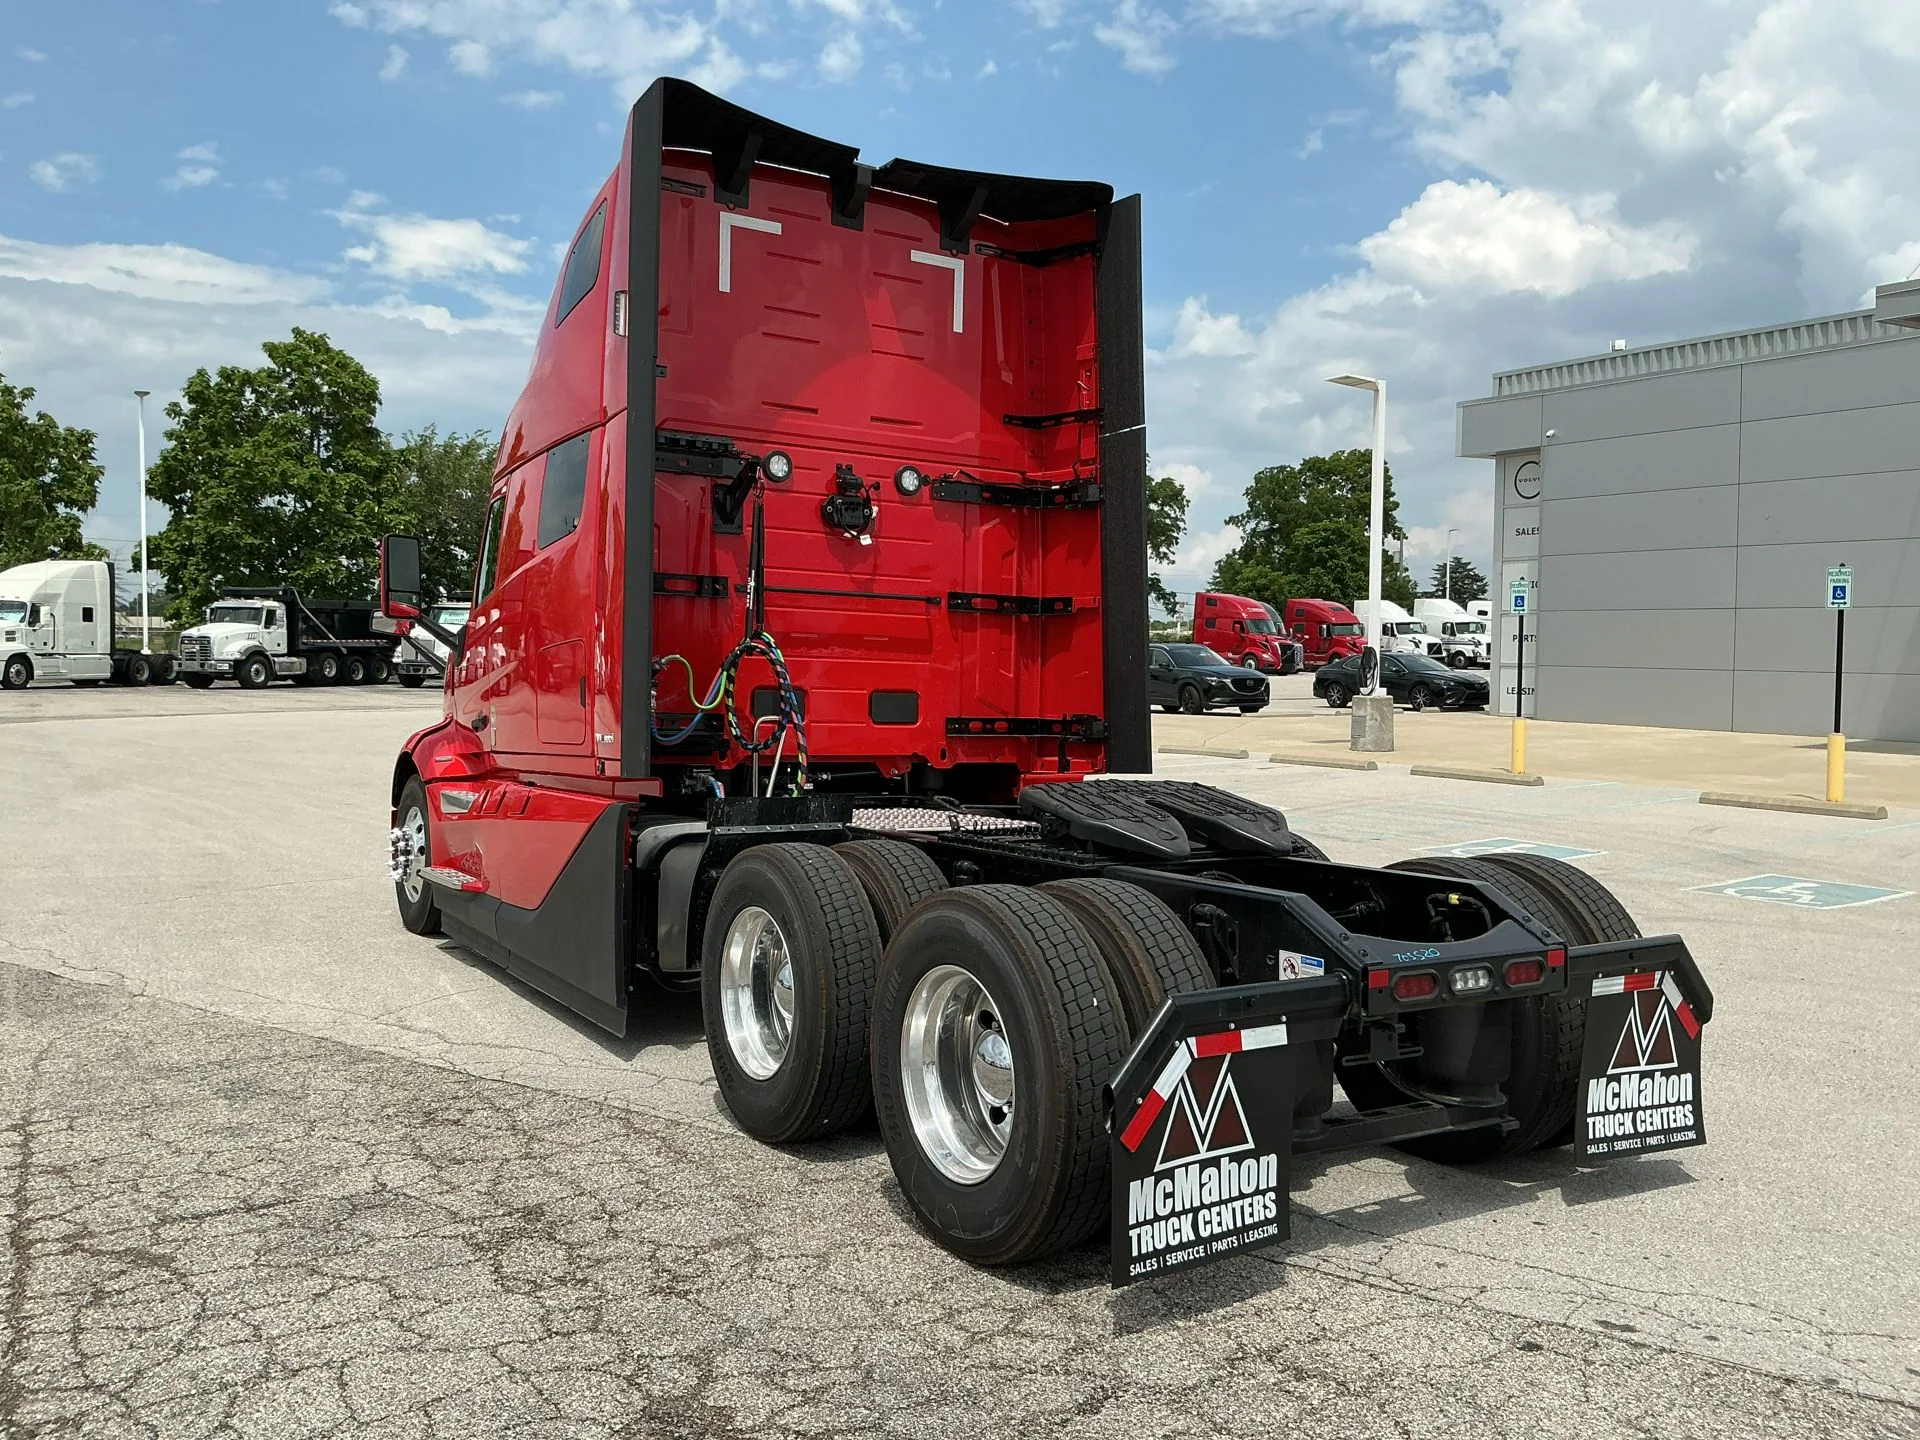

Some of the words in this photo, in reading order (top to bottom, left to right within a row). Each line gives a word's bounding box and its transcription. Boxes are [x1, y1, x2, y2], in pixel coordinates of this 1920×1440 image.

[1515, 527, 1540, 536] SALES
[1512, 634, 1537, 643] PRT
[1587, 1071, 1693, 1114] McMahon
[1586, 1111, 1635, 1139] TRUCK
[1636, 1103, 1694, 1133] CENTERS
[1586, 1143, 1608, 1154] SALES
[1614, 1138, 1642, 1150] SERVICE
[1646, 1134, 1666, 1146] PARTS
[1670, 1130, 1697, 1143] LEASING
[1128, 1153, 1278, 1226] McMahon
[1128, 1213, 1196, 1257] TRUCK
[1197, 1191, 1277, 1238] CENTERS
[1129, 1257, 1158, 1276] SALES
[1165, 1245, 1206, 1266] SERVICE
[1212, 1236, 1239, 1253] PARTS
[1244, 1223, 1278, 1244] LEASING
